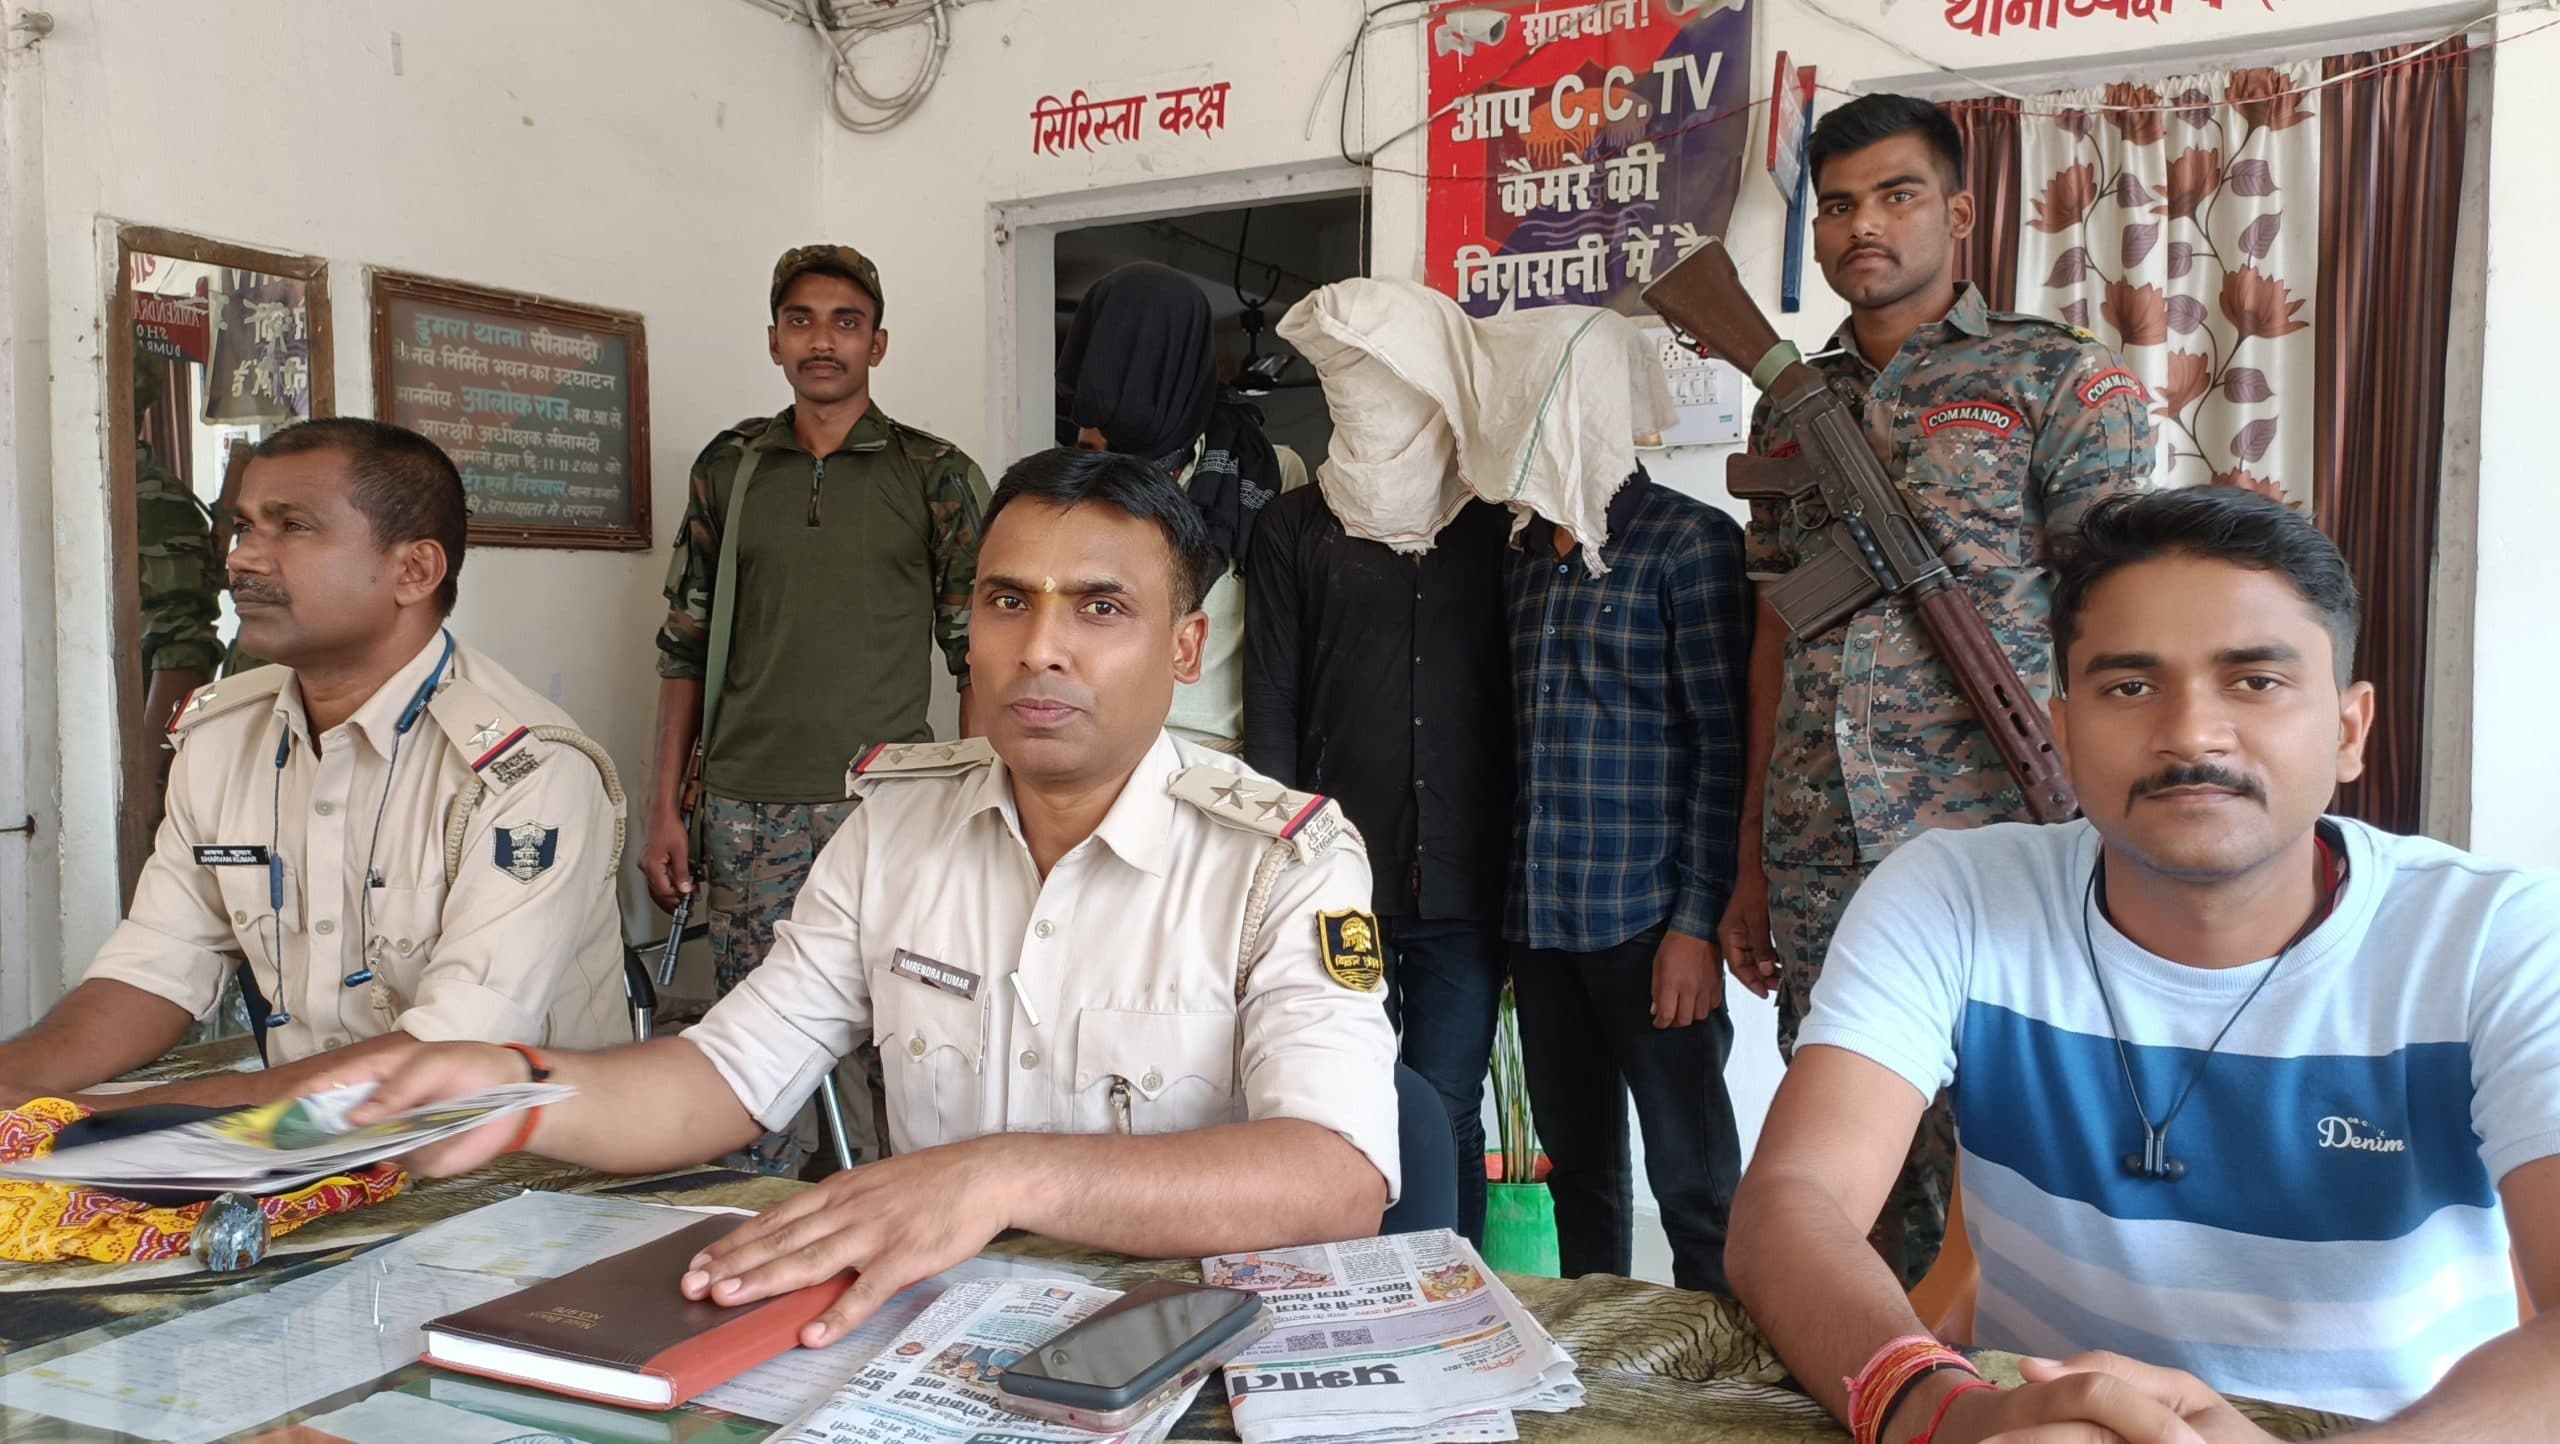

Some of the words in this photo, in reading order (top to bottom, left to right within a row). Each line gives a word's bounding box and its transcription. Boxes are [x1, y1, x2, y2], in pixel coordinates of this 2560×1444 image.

[1520, 0, 1649, 46] सावधान!
[1030, 89, 1148, 158] सिरिस्ता
[1156, 81, 1231, 139] कक्ष
[1451, 88, 1535, 142] आप
[1497, 152, 1595, 217] कैमरे
[1605, 141, 1665, 204] की
[1453, 232, 1610, 303] निगरानी
[1622, 223, 1664, 283] में
[415, 313, 469, 347] डुमरा
[474, 321, 522, 348] थाना
[492, 356, 528, 380] भवन
[530, 361, 549, 382] का
[460, 380, 534, 416] आलोक
[418, 416, 474, 445] आरक्षी
[1929, 407, 2010, 429] COMMANDO
[605, 456, 621, 474] को
[900, 958, 940, 981] AMRENDRA
[942, 971, 969, 990] KUMAR
[2317, 1116, 2405, 1152] Denim
[1232, 1363, 1405, 1398] प्रभात
